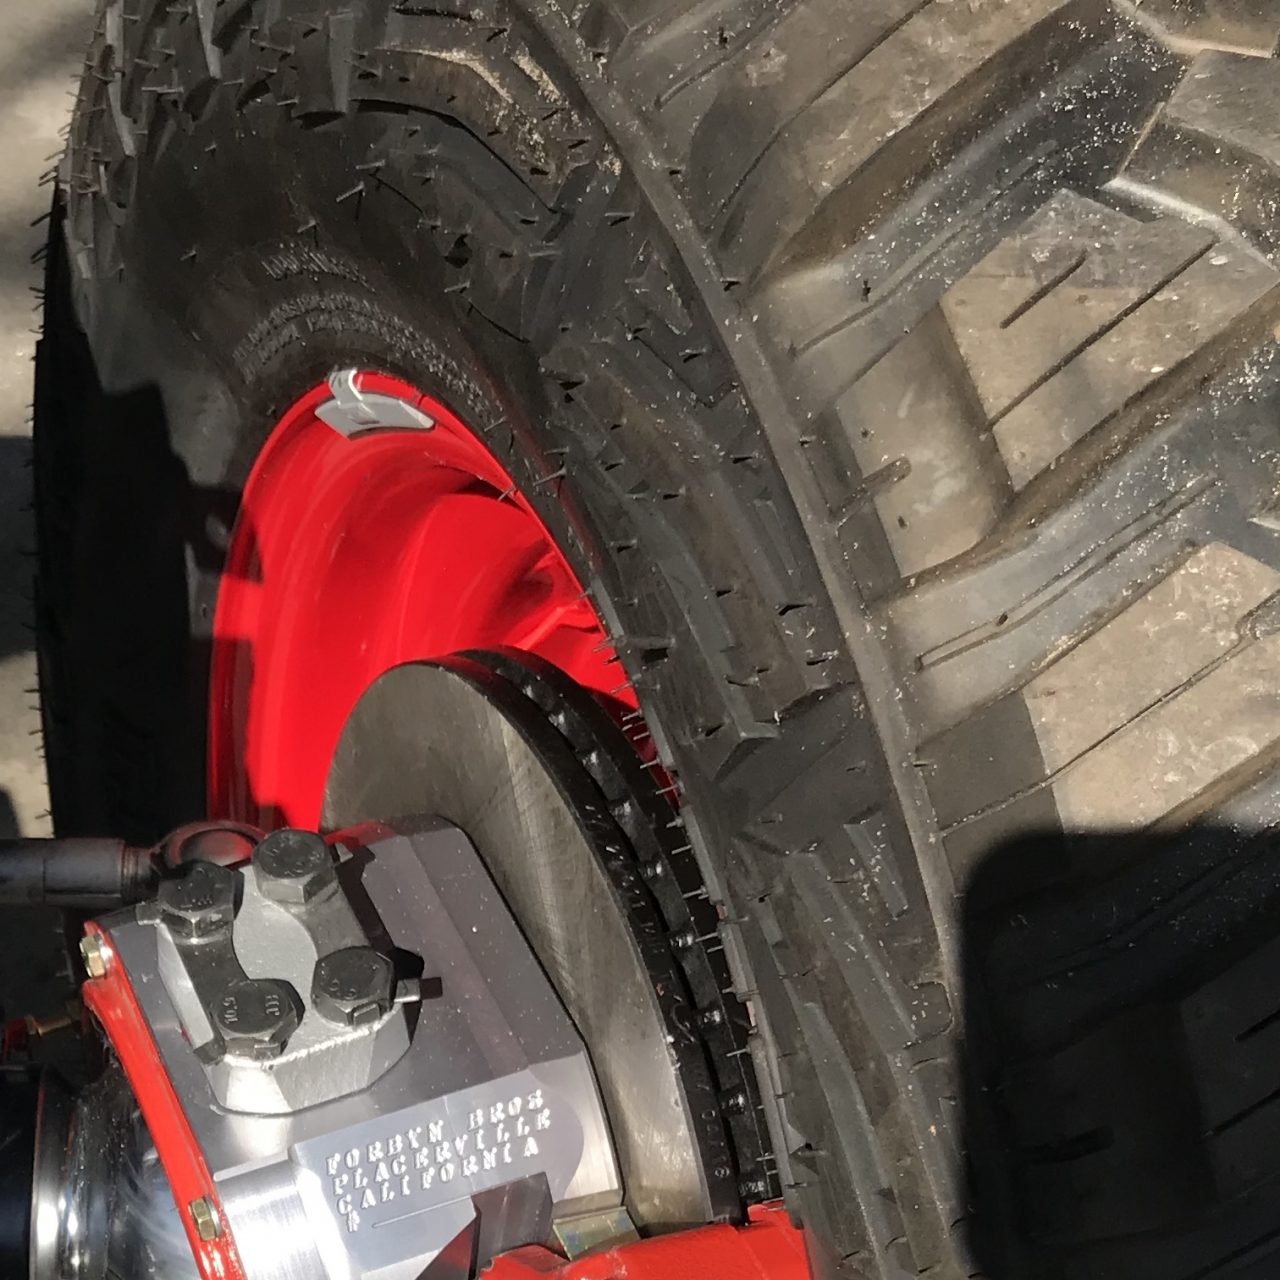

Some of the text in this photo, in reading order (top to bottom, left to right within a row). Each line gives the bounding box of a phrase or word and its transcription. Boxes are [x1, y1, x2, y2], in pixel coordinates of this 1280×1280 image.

[468, 1088, 544, 1131] BROS
[333, 1108, 551, 1196] PLACERVILLE
[337, 1136, 539, 1215] CALIFORNIA
